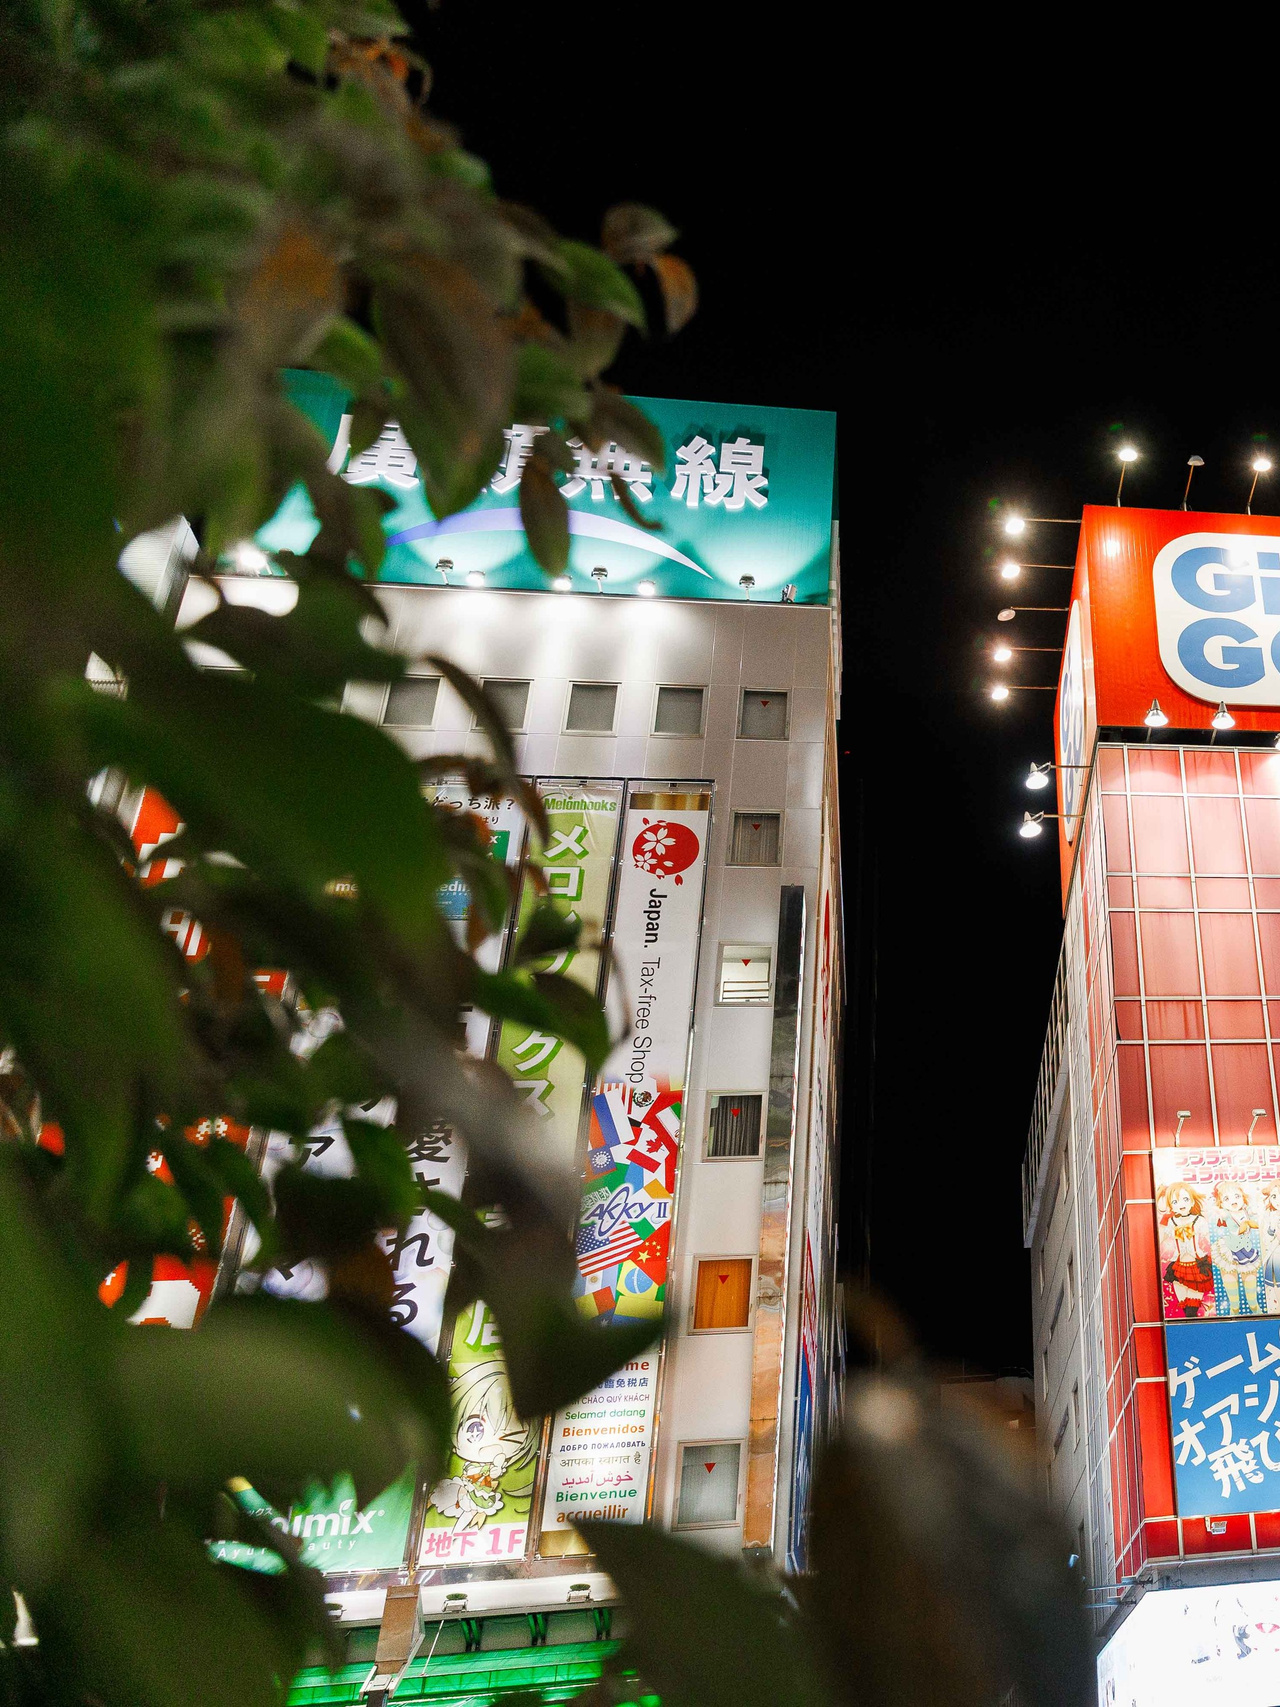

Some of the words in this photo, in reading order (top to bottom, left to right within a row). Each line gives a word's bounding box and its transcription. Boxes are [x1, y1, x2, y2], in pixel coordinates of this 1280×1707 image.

[544, 793, 617, 812] Melonbooks
[642, 887, 668, 949] Japan.
[635, 956, 662, 1030] Tax-free
[624, 1035, 654, 1085] Shop
[565, 1411, 607, 1421] Selamat
[609, 1408, 646, 1420] datang
[562, 1423, 645, 1438] Bienvenidos
[559, 1443, 588, 1453] ДОБРО
[591, 1440, 646, 1451] ПОЖАЛОВАТЬ
[556, 1487, 638, 1503] Bienvenue
[556, 1504, 629, 1523] accueillir
